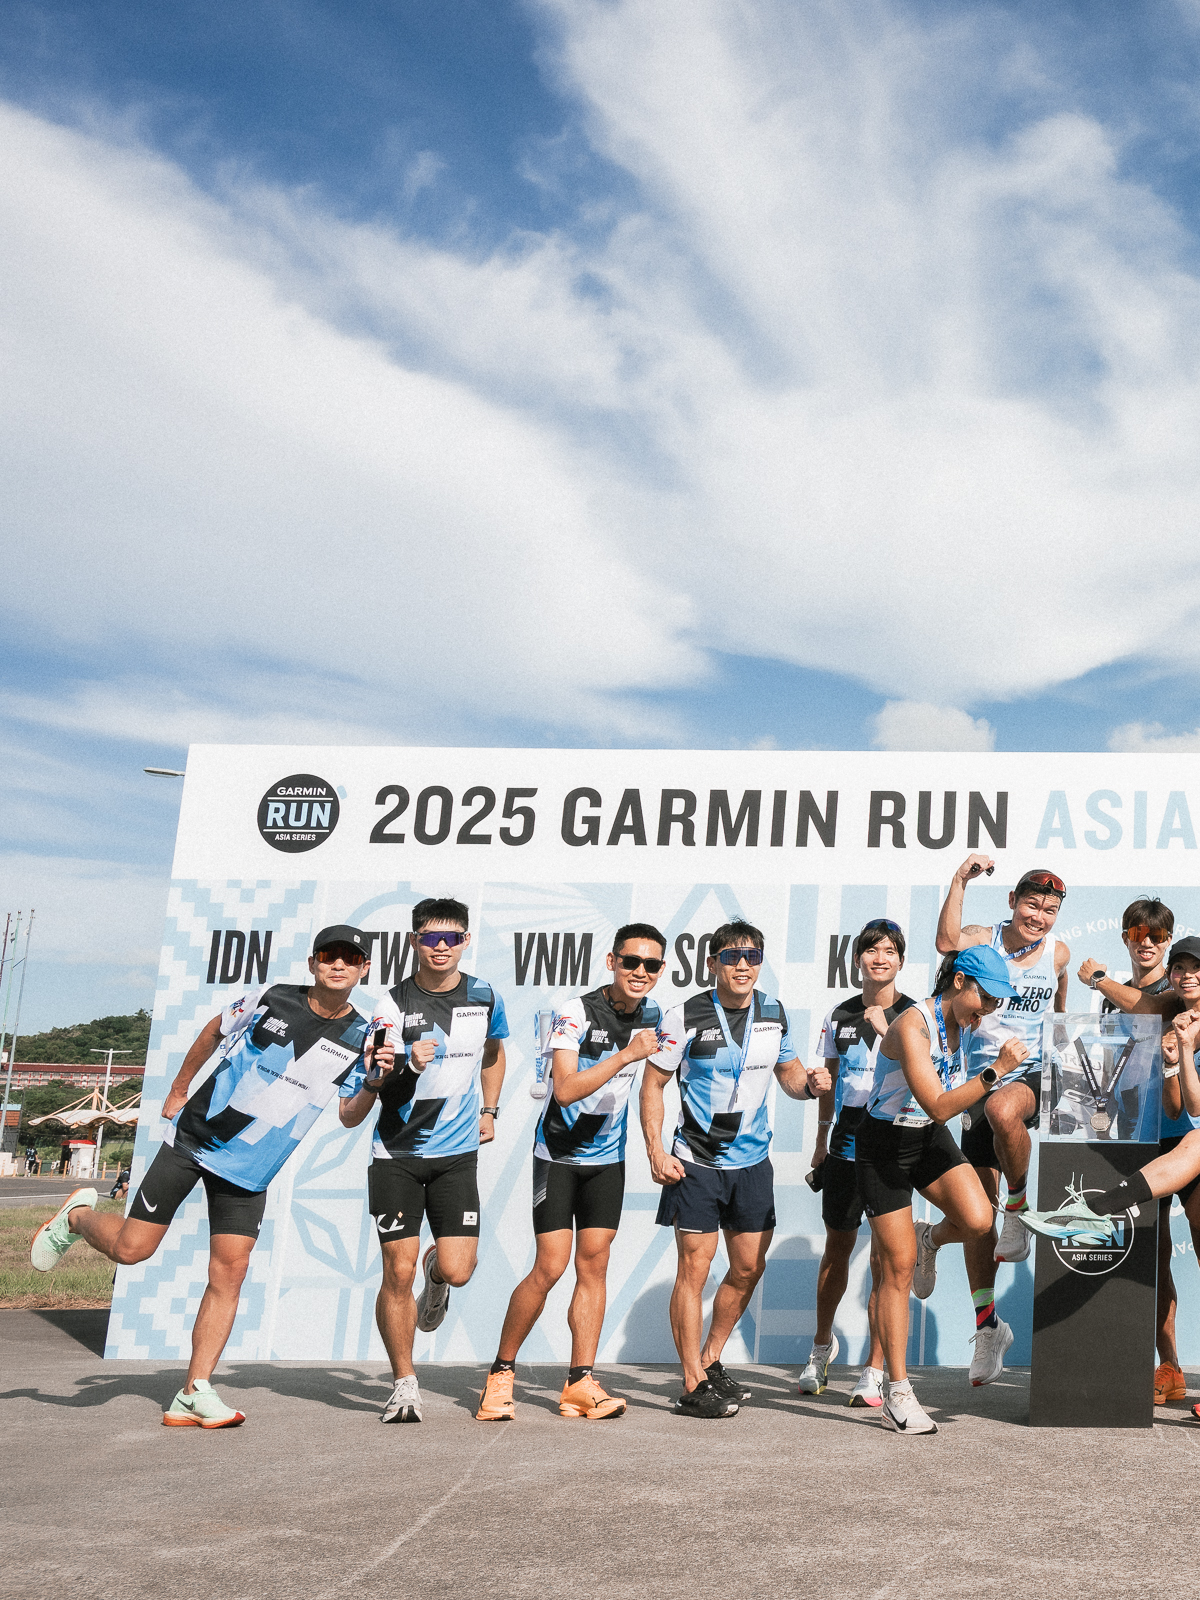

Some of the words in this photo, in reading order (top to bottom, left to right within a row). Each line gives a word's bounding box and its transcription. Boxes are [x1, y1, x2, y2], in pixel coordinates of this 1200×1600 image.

[277, 787, 326, 796] GARMIN
[266, 802, 332, 827] RUN
[369, 785, 538, 846] 2025
[560, 788, 839, 848] GARMIN
[867, 790, 1009, 849] RUN
[1035, 789, 1198, 850] ASIA
[275, 833, 290, 841] ASIA
[1086, 918, 1122, 934] KON
[206, 930, 273, 984] IDN
[514, 932, 593, 986] VNM
[1022, 986, 1053, 1000] ZERO
[320, 1044, 349, 1061] GARMIN
